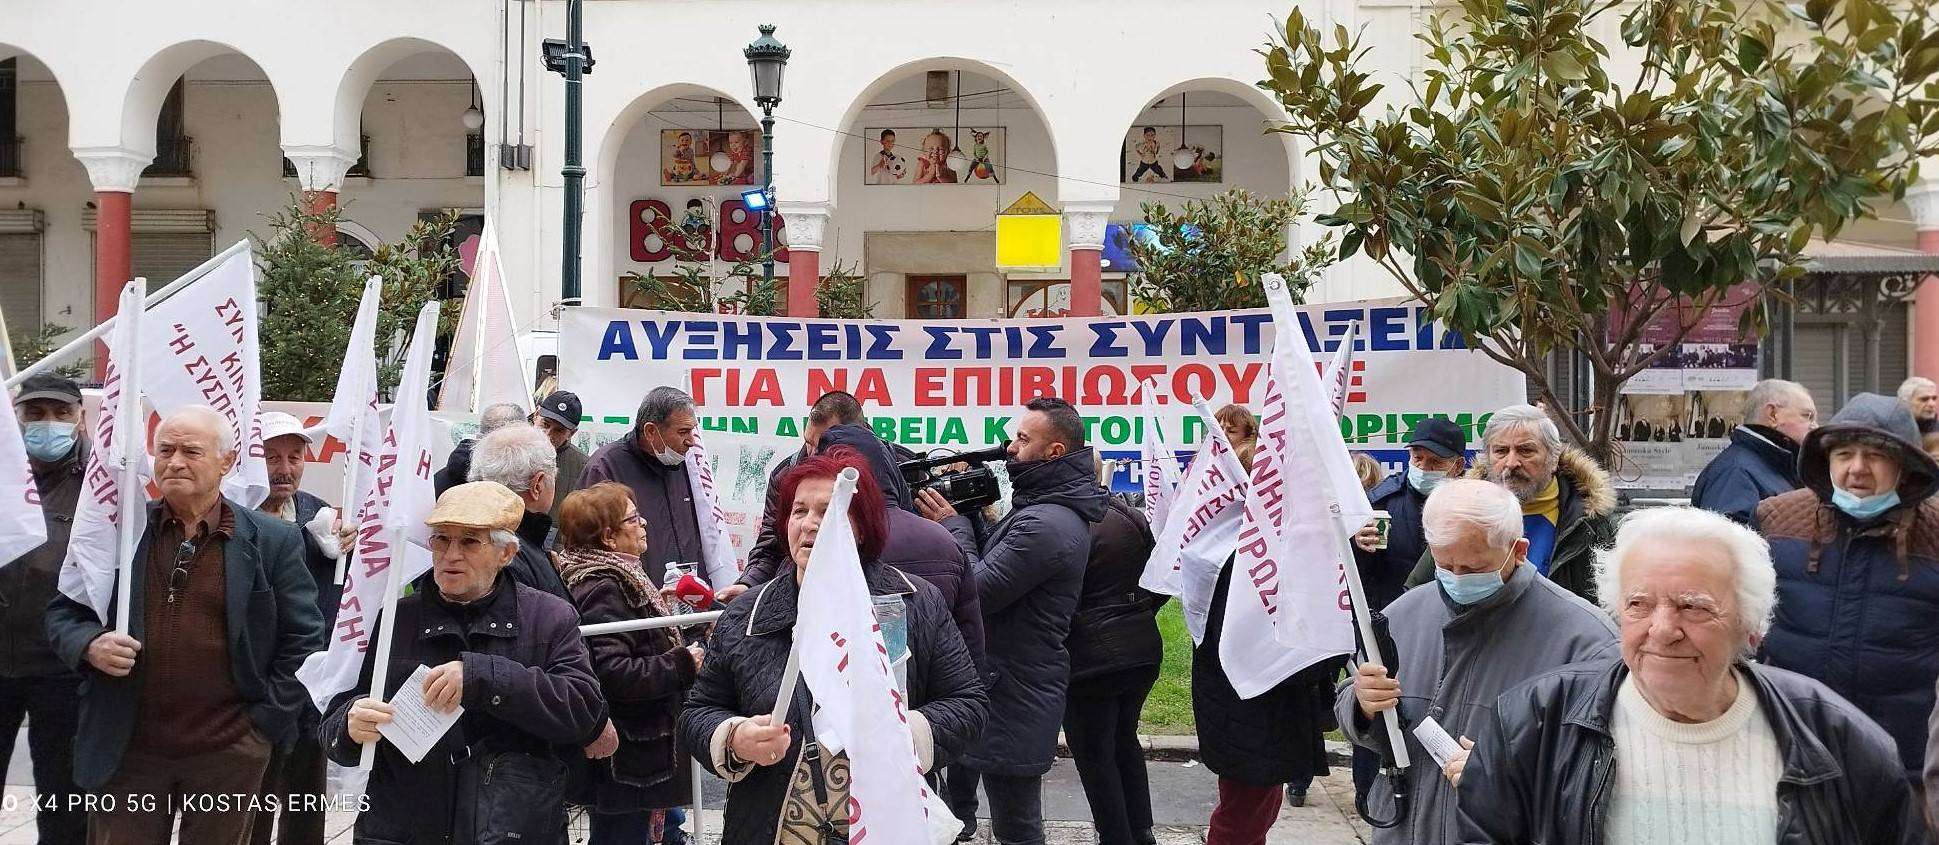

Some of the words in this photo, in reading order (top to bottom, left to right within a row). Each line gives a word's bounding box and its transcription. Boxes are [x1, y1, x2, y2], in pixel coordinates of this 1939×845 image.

[597, 320, 905, 361] ΑΥΞΗΣΕΙΣ
[924, 325, 1066, 361] ΣΤΙΣ
[690, 367, 785, 407] ΓΙΑ
[806, 367, 893, 407] ΝΑ
[914, 360, 1367, 408] ΕΠΙΒΙΩΣΟΥΕ
[774, 415, 969, 446] ΑΒΕΙΑ
